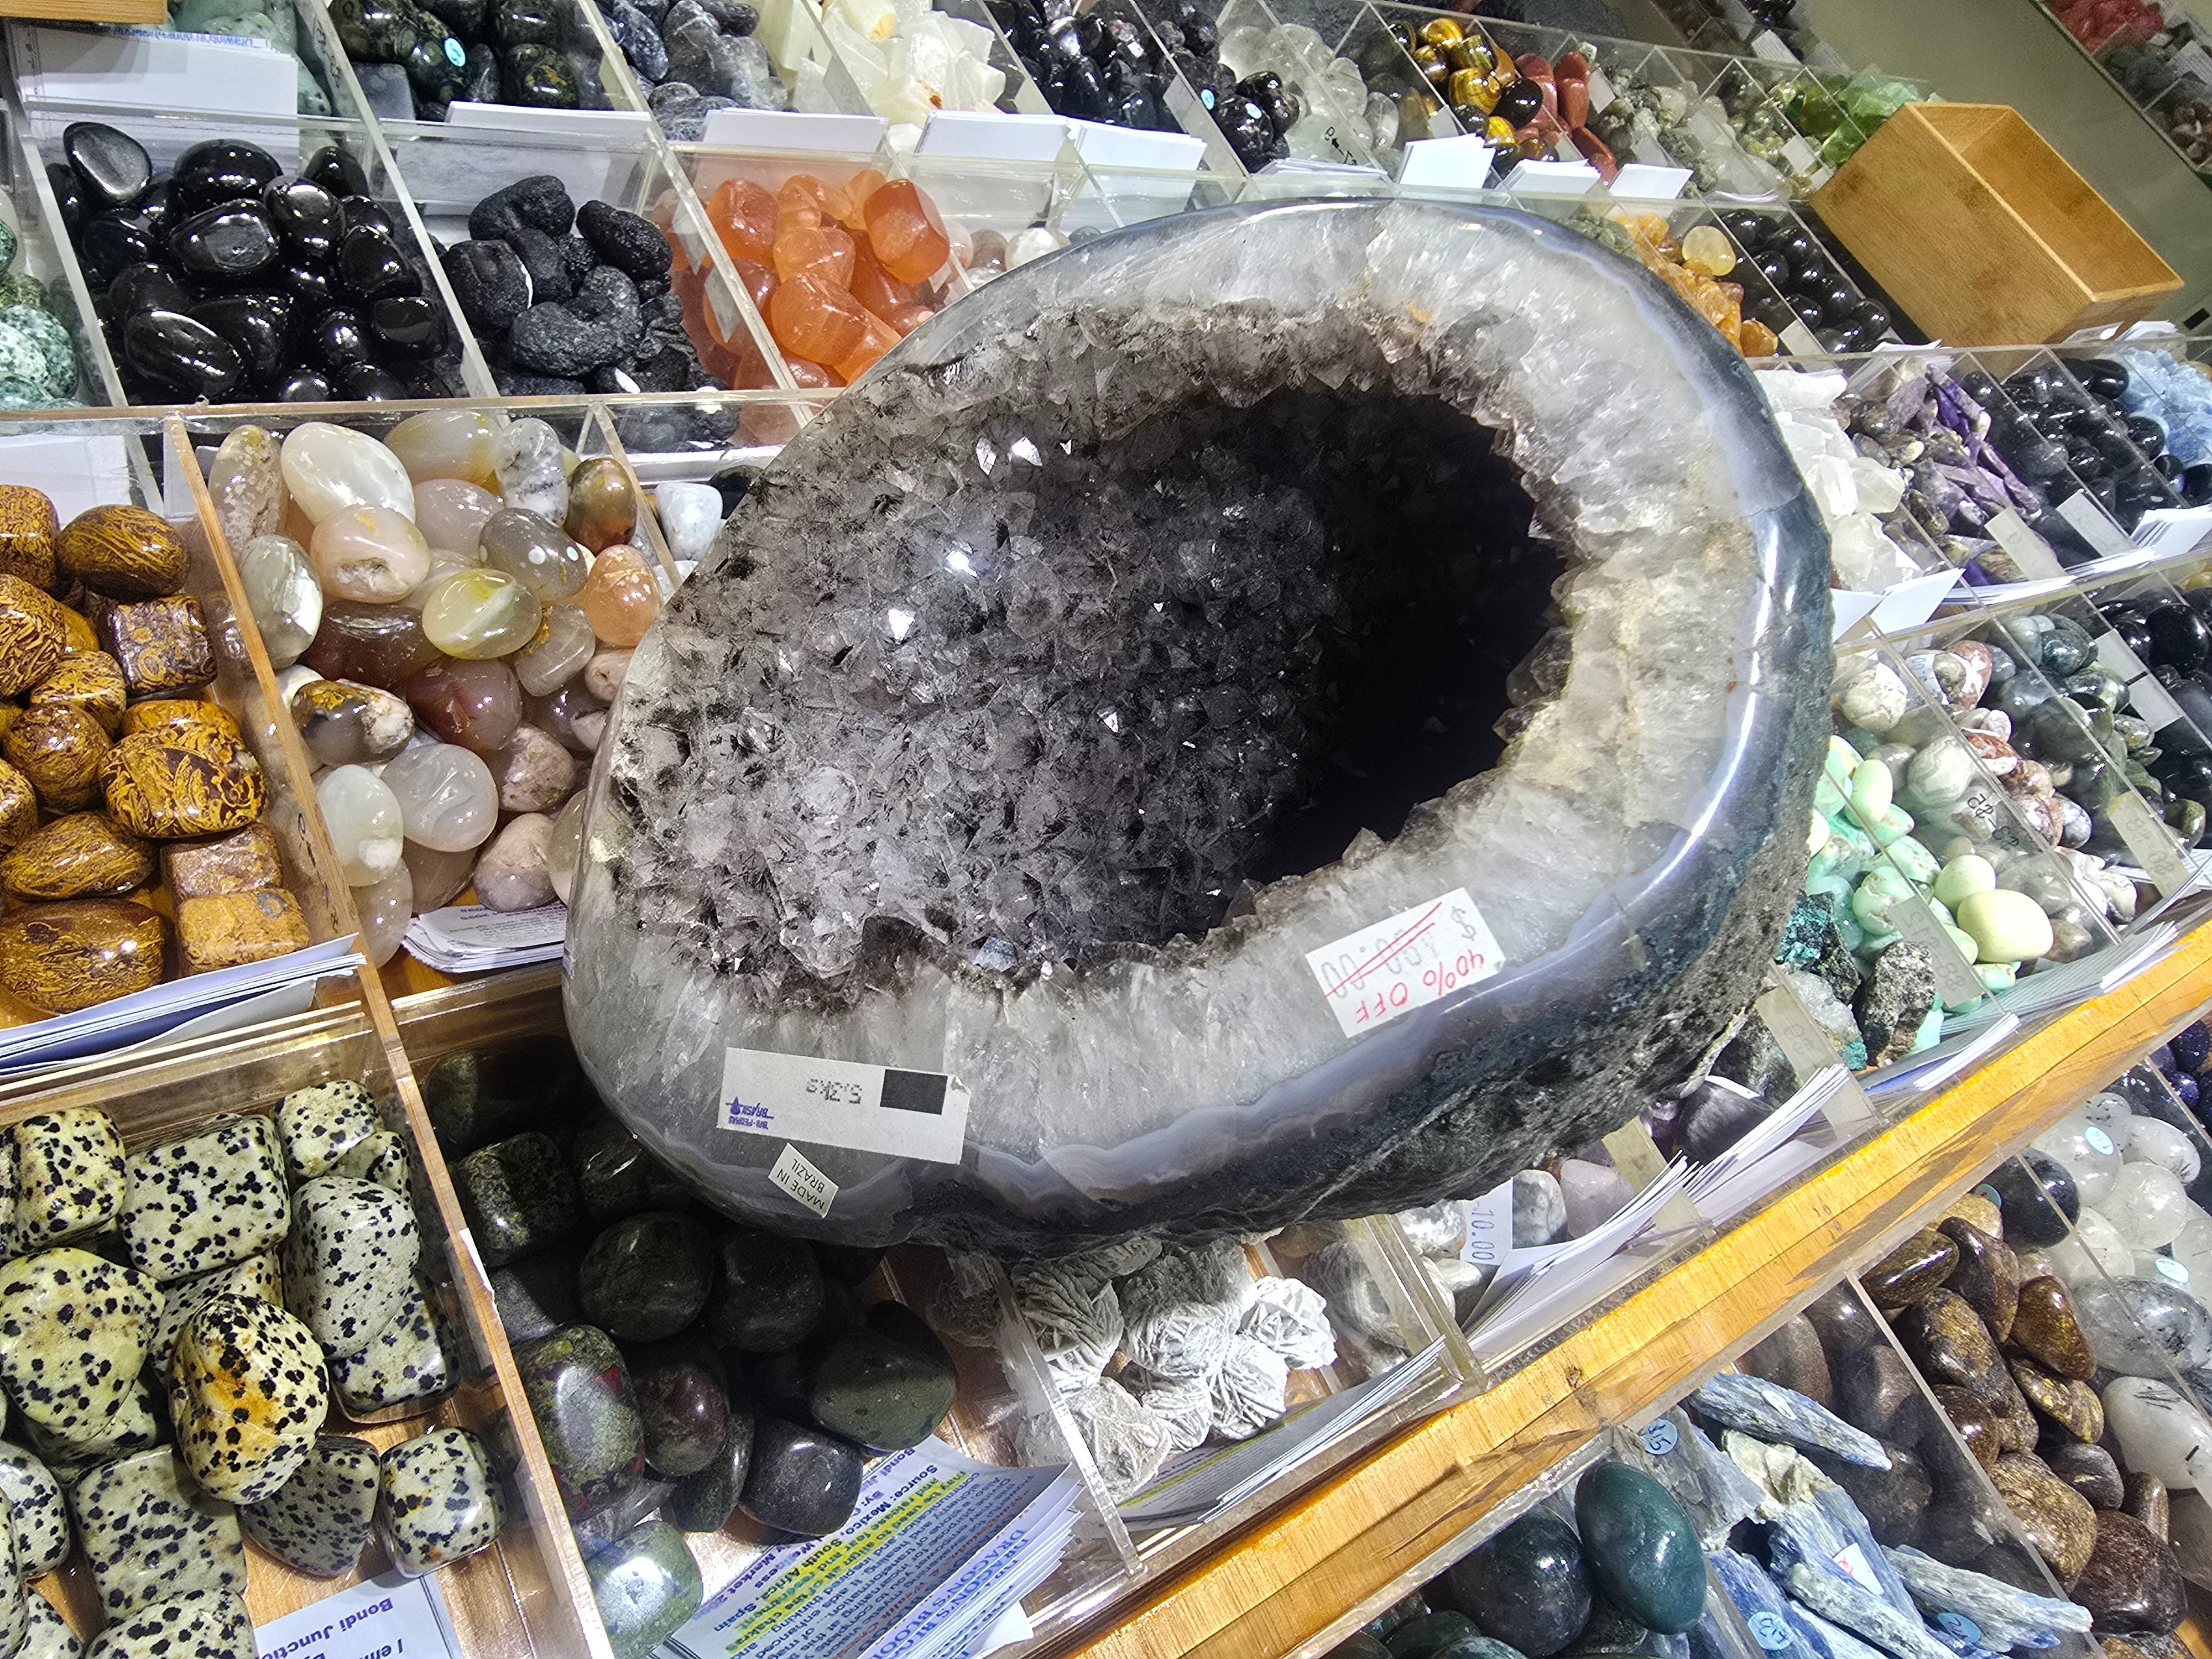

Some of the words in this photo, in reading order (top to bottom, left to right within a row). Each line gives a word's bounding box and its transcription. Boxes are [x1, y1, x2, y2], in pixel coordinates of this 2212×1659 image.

[1417, 946, 1490, 1000] 40%
[1348, 980, 1412, 1024] OFF
[776, 1168, 790, 1185] IN
[787, 1158, 826, 1193] BRAZIL
[789, 1180, 825, 1209] MADE
[889, 1463, 938, 1503] Source:
[914, 1478, 939, 1499] and
[938, 1469, 967, 1491] may
[859, 1488, 884, 1510] By:
[897, 1471, 980, 1538] communication
[922, 1490, 941, 1506] be
[932, 1482, 980, 1520] alchemy
[839, 1499, 892, 1541] Mexico,
[870, 1496, 915, 1532] release
[891, 1503, 923, 1531] used
[927, 1506, 975, 1547] purpose
[843, 1530, 871, 1553] fear
[875, 1527, 891, 1542] to
[908, 1520, 932, 1541] and
[915, 1535, 928, 1548] of
[801, 1536, 843, 1572] South
[842, 1540, 875, 1568] align
[872, 1536, 898, 1558] and
[911, 1546, 929, 1562] for
[727, 1551, 775, 1597] Market
[816, 1550, 843, 1574] and
[824, 1564, 842, 1582] all
[931, 1526, 1026, 1610] DRAGON'S
[808, 1578, 825, 1596] of
[822, 1555, 873, 1598] inspired
[889, 1568, 914, 1591] you
[784, 1591, 808, 1614] the
[821, 1585, 849, 1612] aids
[841, 1561, 910, 1621] incarnating
[874, 1590, 889, 1605] to
[338, 1598, 393, 1632] Bondi
[713, 1599, 757, 1636] Spain
[826, 1618, 841, 1634] at
[255, 1626, 333, 1659] Junctio
[725, 1609, 782, 1656] chakras
[800, 1625, 815, 1642] of
[800, 1630, 826, 1655] this
